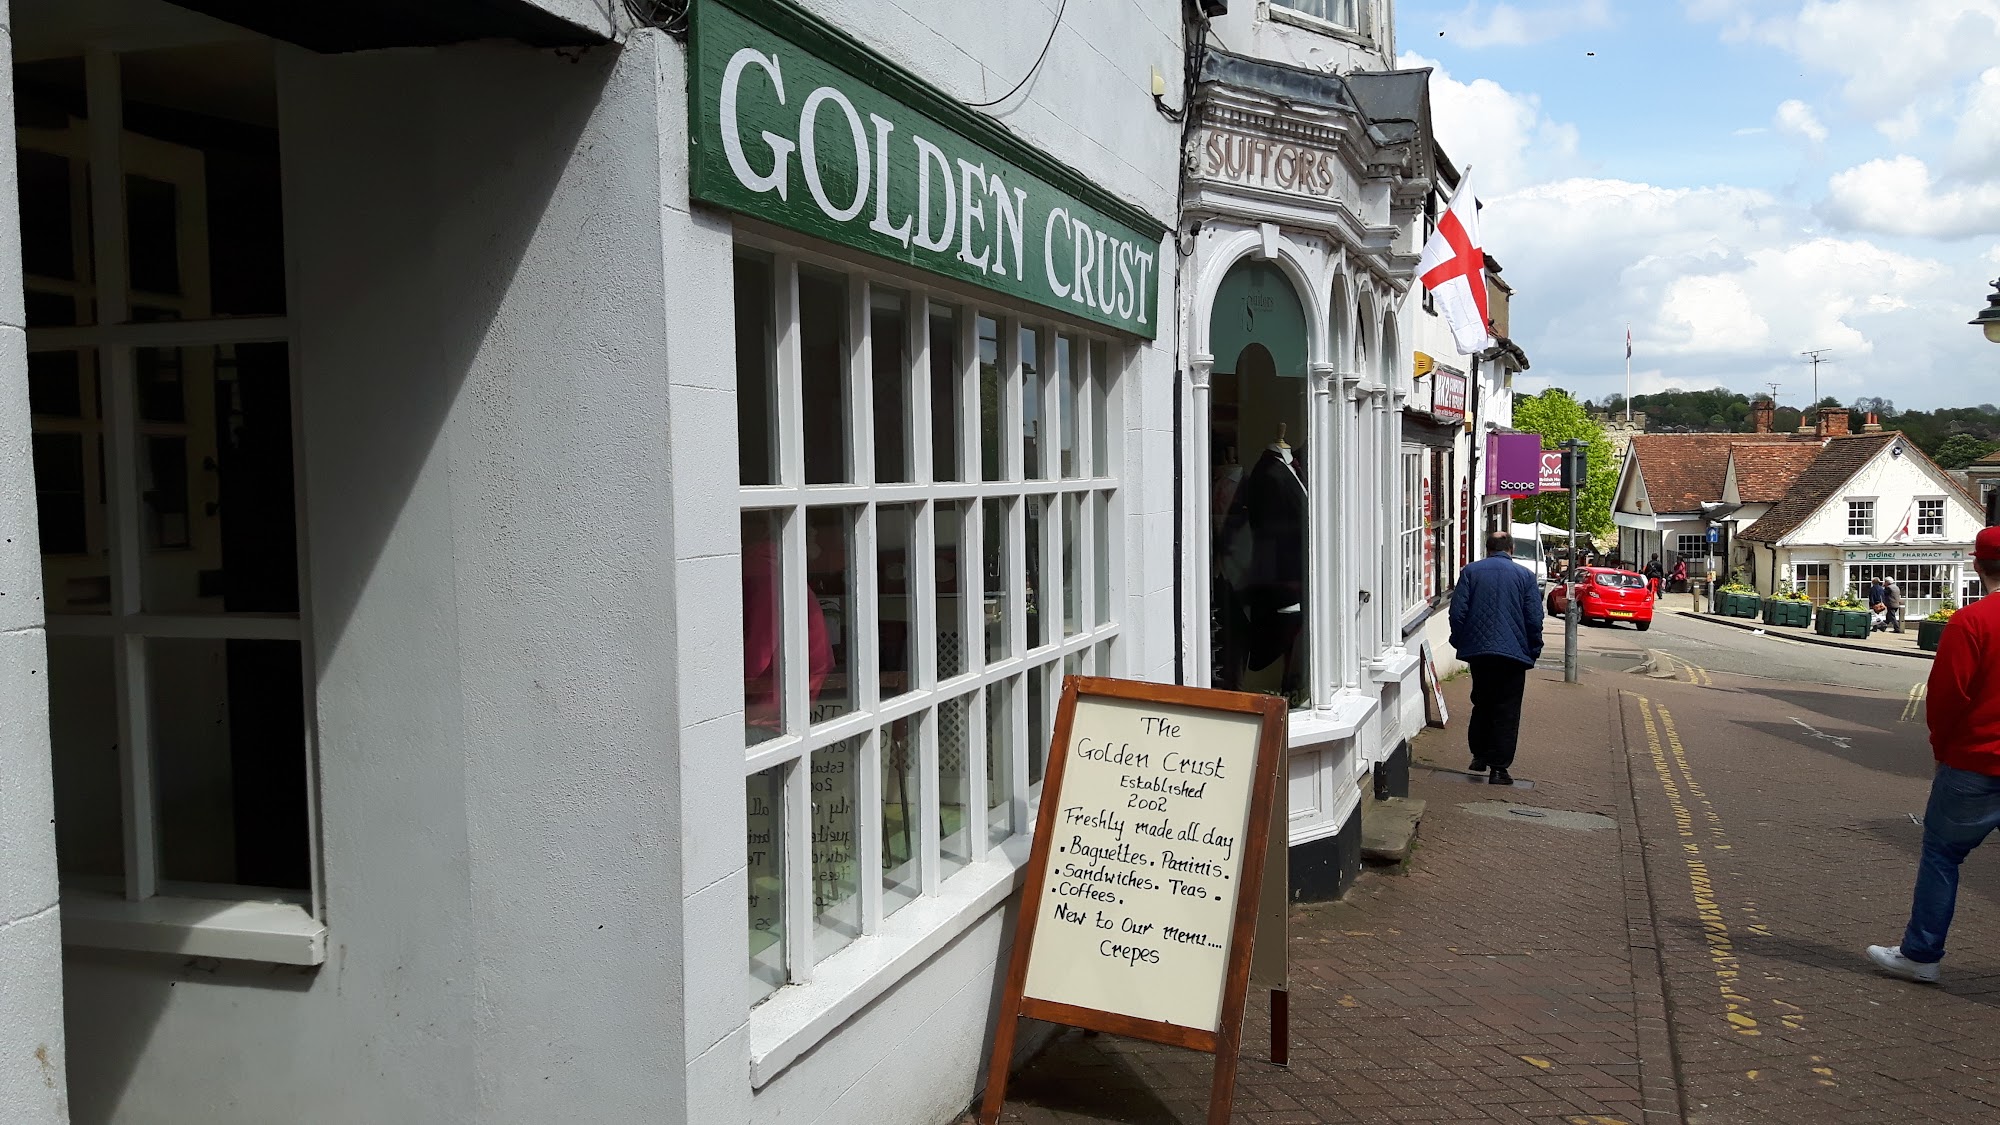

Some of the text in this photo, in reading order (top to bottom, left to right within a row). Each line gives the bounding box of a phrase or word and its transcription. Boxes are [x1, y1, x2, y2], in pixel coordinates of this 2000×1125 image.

[1206, 130, 1334, 195] SUITORS
[720, 47, 1154, 325] GOLDEN CRUST
[1500, 480, 1535, 491] Scope
[1866, 551, 1896, 559] jardines
[1140, 717, 1182, 738] The
[1077, 737, 1226, 779] Golden Crust
[1120, 775, 1207, 799] Established
[1127, 793, 1167, 812] 2002
[1064, 806, 1234, 861] Freshly made all day
[1054, 902, 1087, 925] New
[1096, 910, 1114, 930] to
[1121, 917, 1154, 935] Our
[1099, 939, 1160, 967] Crepes
